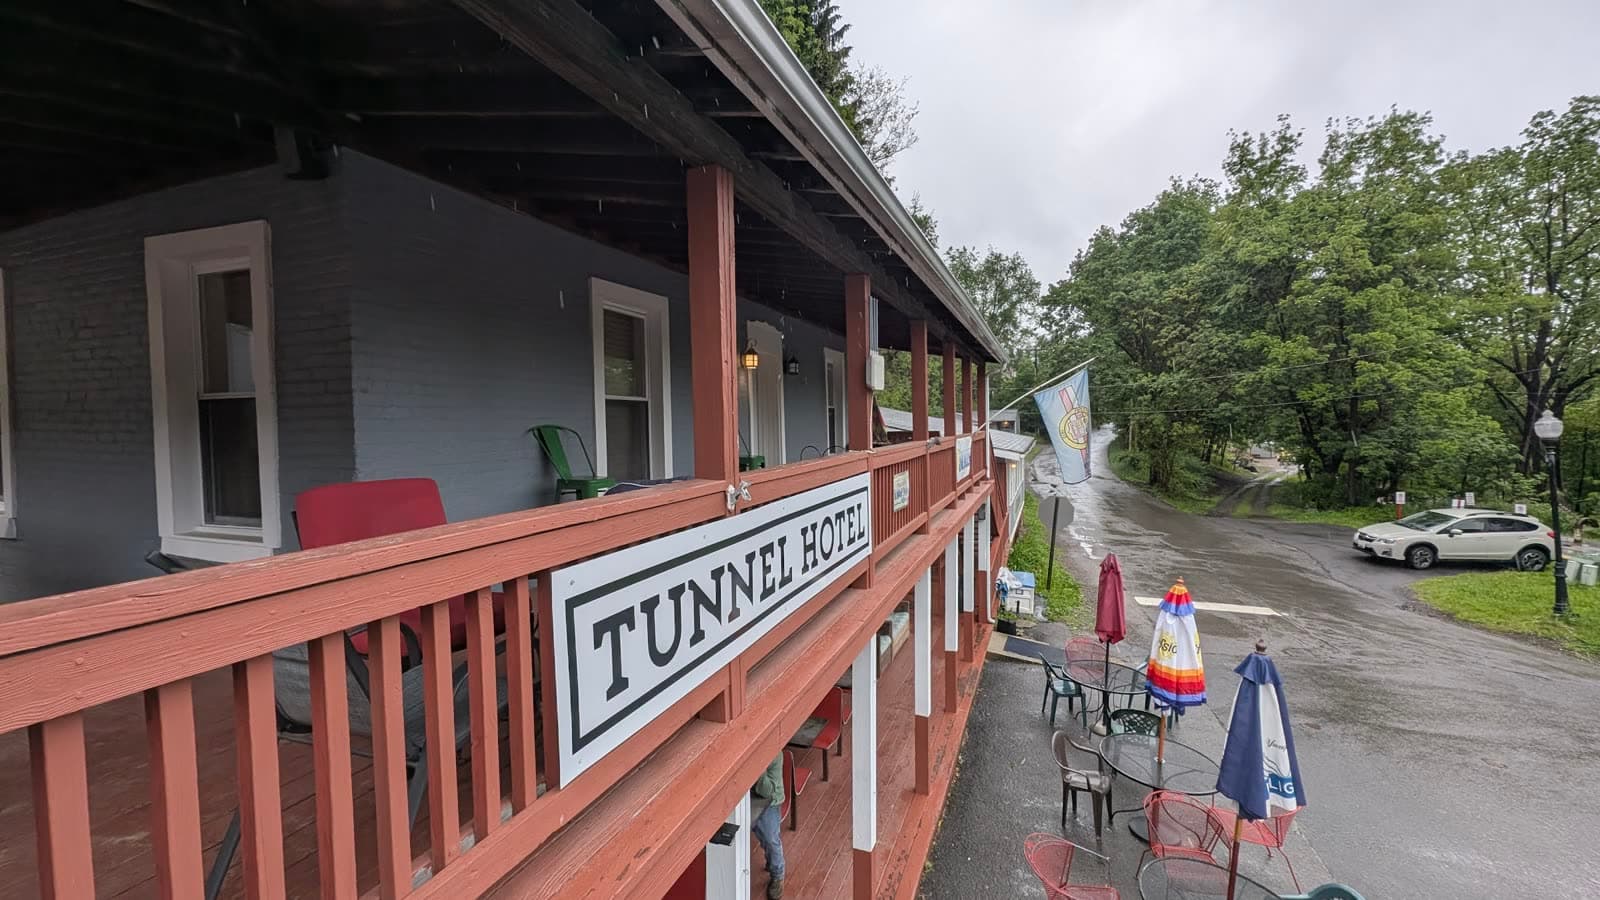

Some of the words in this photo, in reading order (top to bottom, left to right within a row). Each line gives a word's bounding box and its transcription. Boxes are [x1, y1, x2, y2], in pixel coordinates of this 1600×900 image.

[592, 536, 793, 702] TUNNEL
[800, 502, 866, 577] HOTEL
[1267, 777, 1295, 794] LIG
